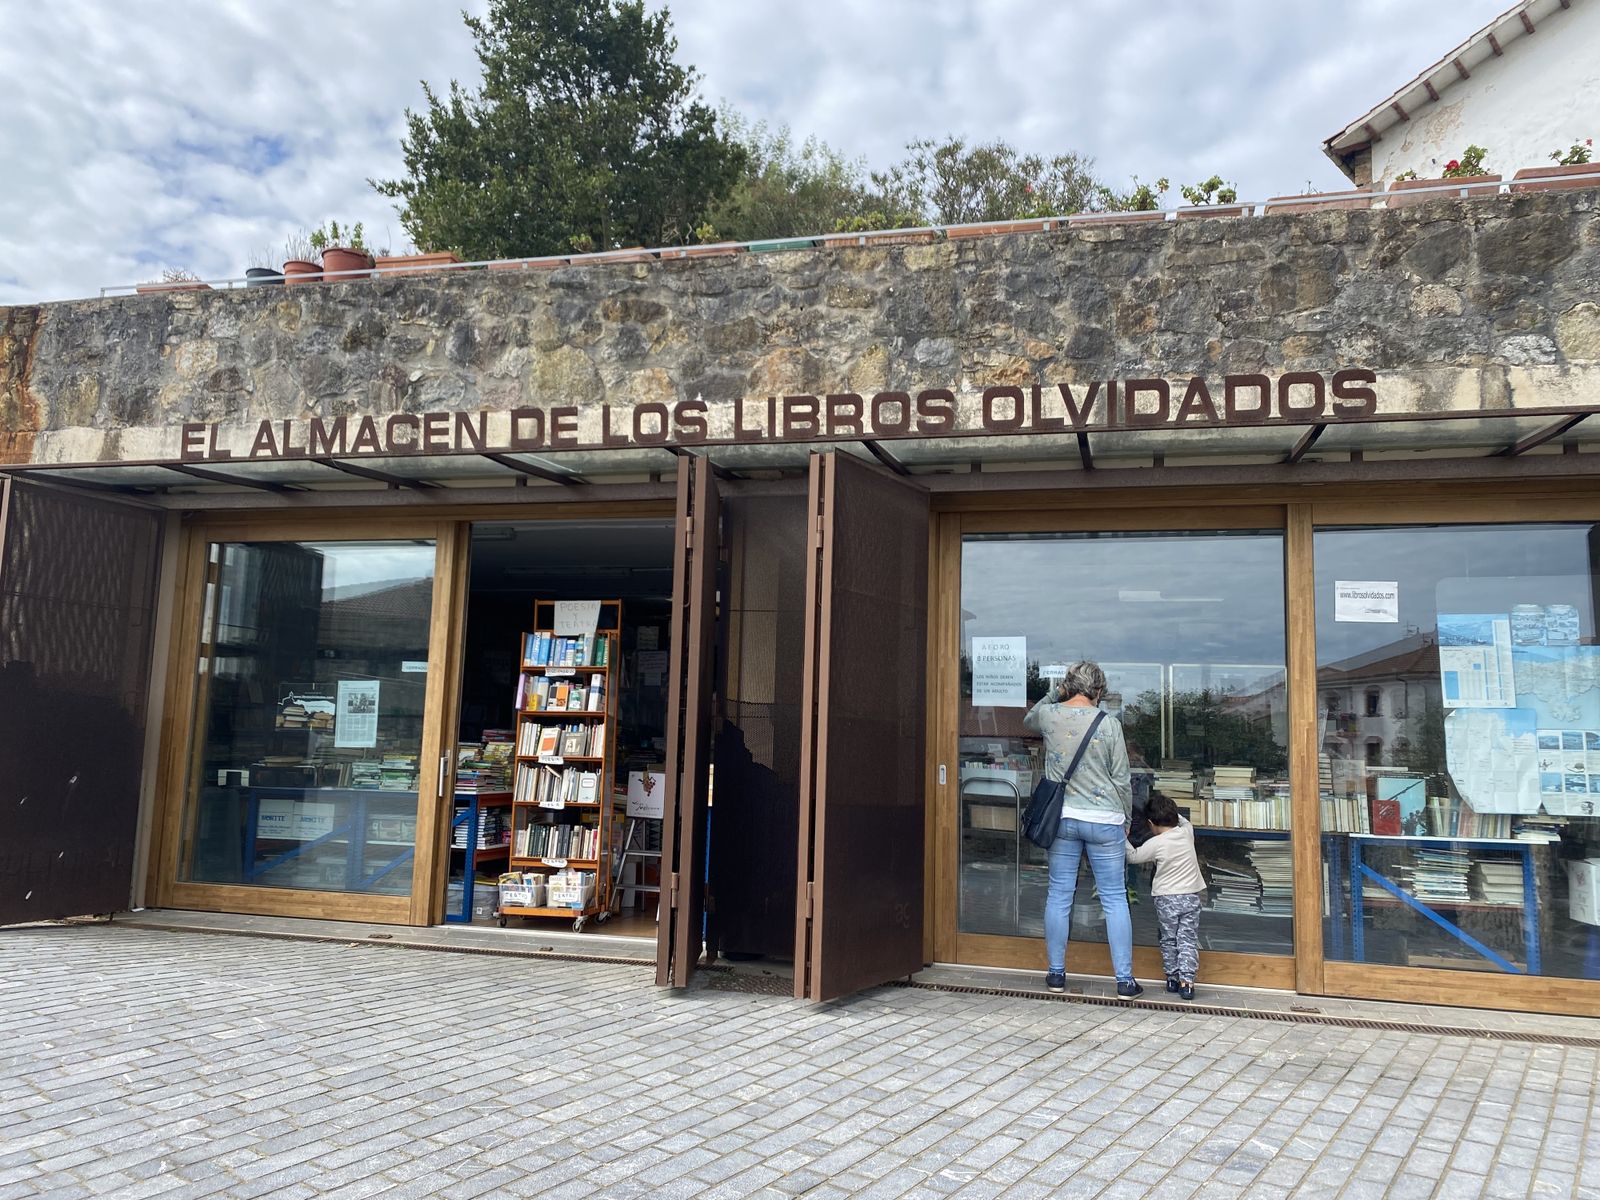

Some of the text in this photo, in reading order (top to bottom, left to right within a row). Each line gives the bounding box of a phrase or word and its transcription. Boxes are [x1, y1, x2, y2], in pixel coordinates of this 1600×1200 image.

[181, 368, 1378, 460] EL ALMACEN DE LOS LIBROS OLVIDADOS
